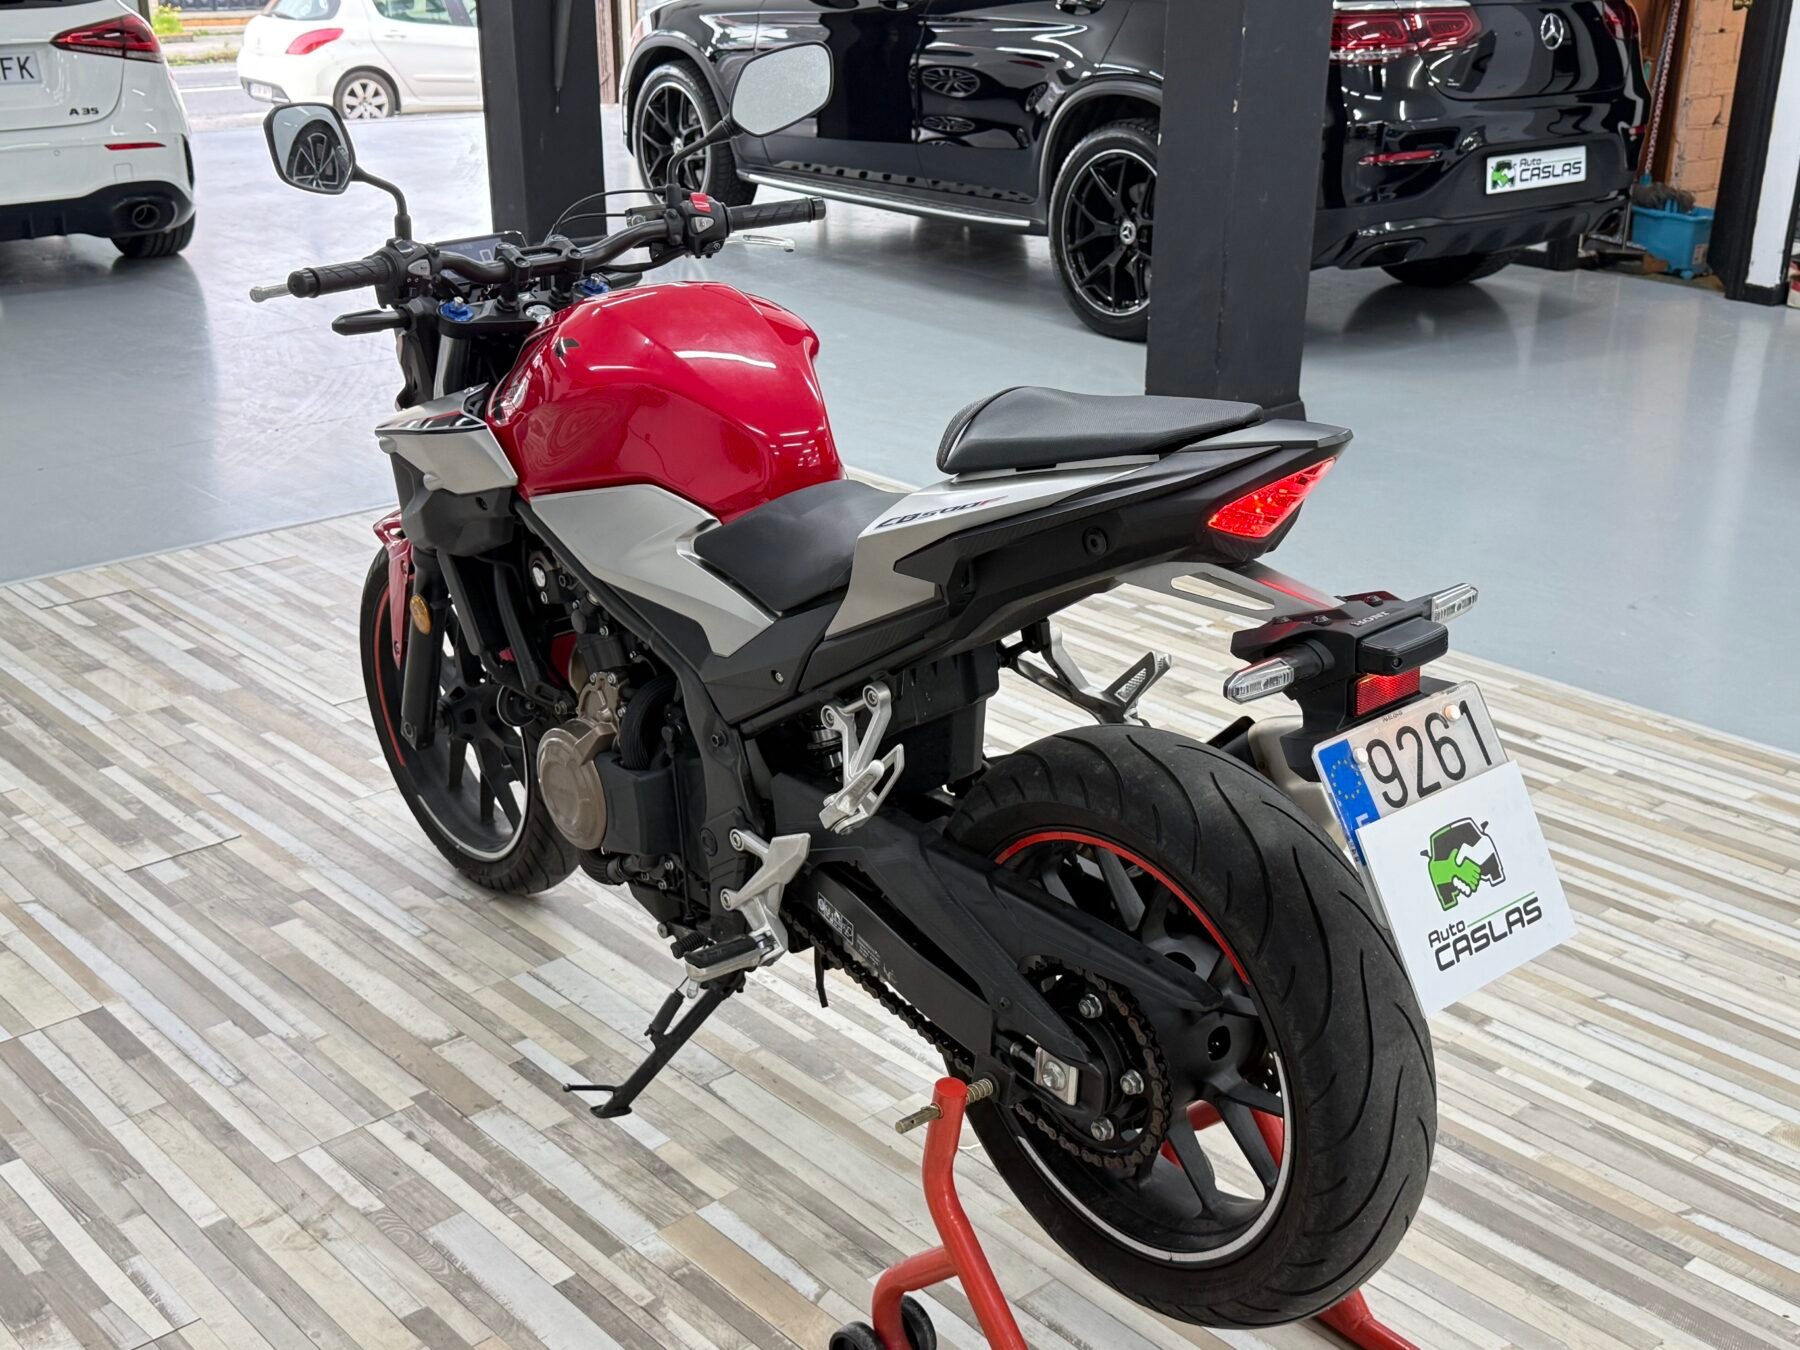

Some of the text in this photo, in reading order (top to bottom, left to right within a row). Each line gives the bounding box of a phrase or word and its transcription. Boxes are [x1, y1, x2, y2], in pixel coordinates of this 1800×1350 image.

[69, 107, 99, 116] A 35
[1519, 158, 1542, 167] Auto
[1519, 161, 1582, 182] CASLAS
[875, 495, 1008, 529] CB500F
[1366, 700, 1493, 809] 9261
[1428, 920, 1466, 948] Auto
[1434, 896, 1543, 972] CASLAS
